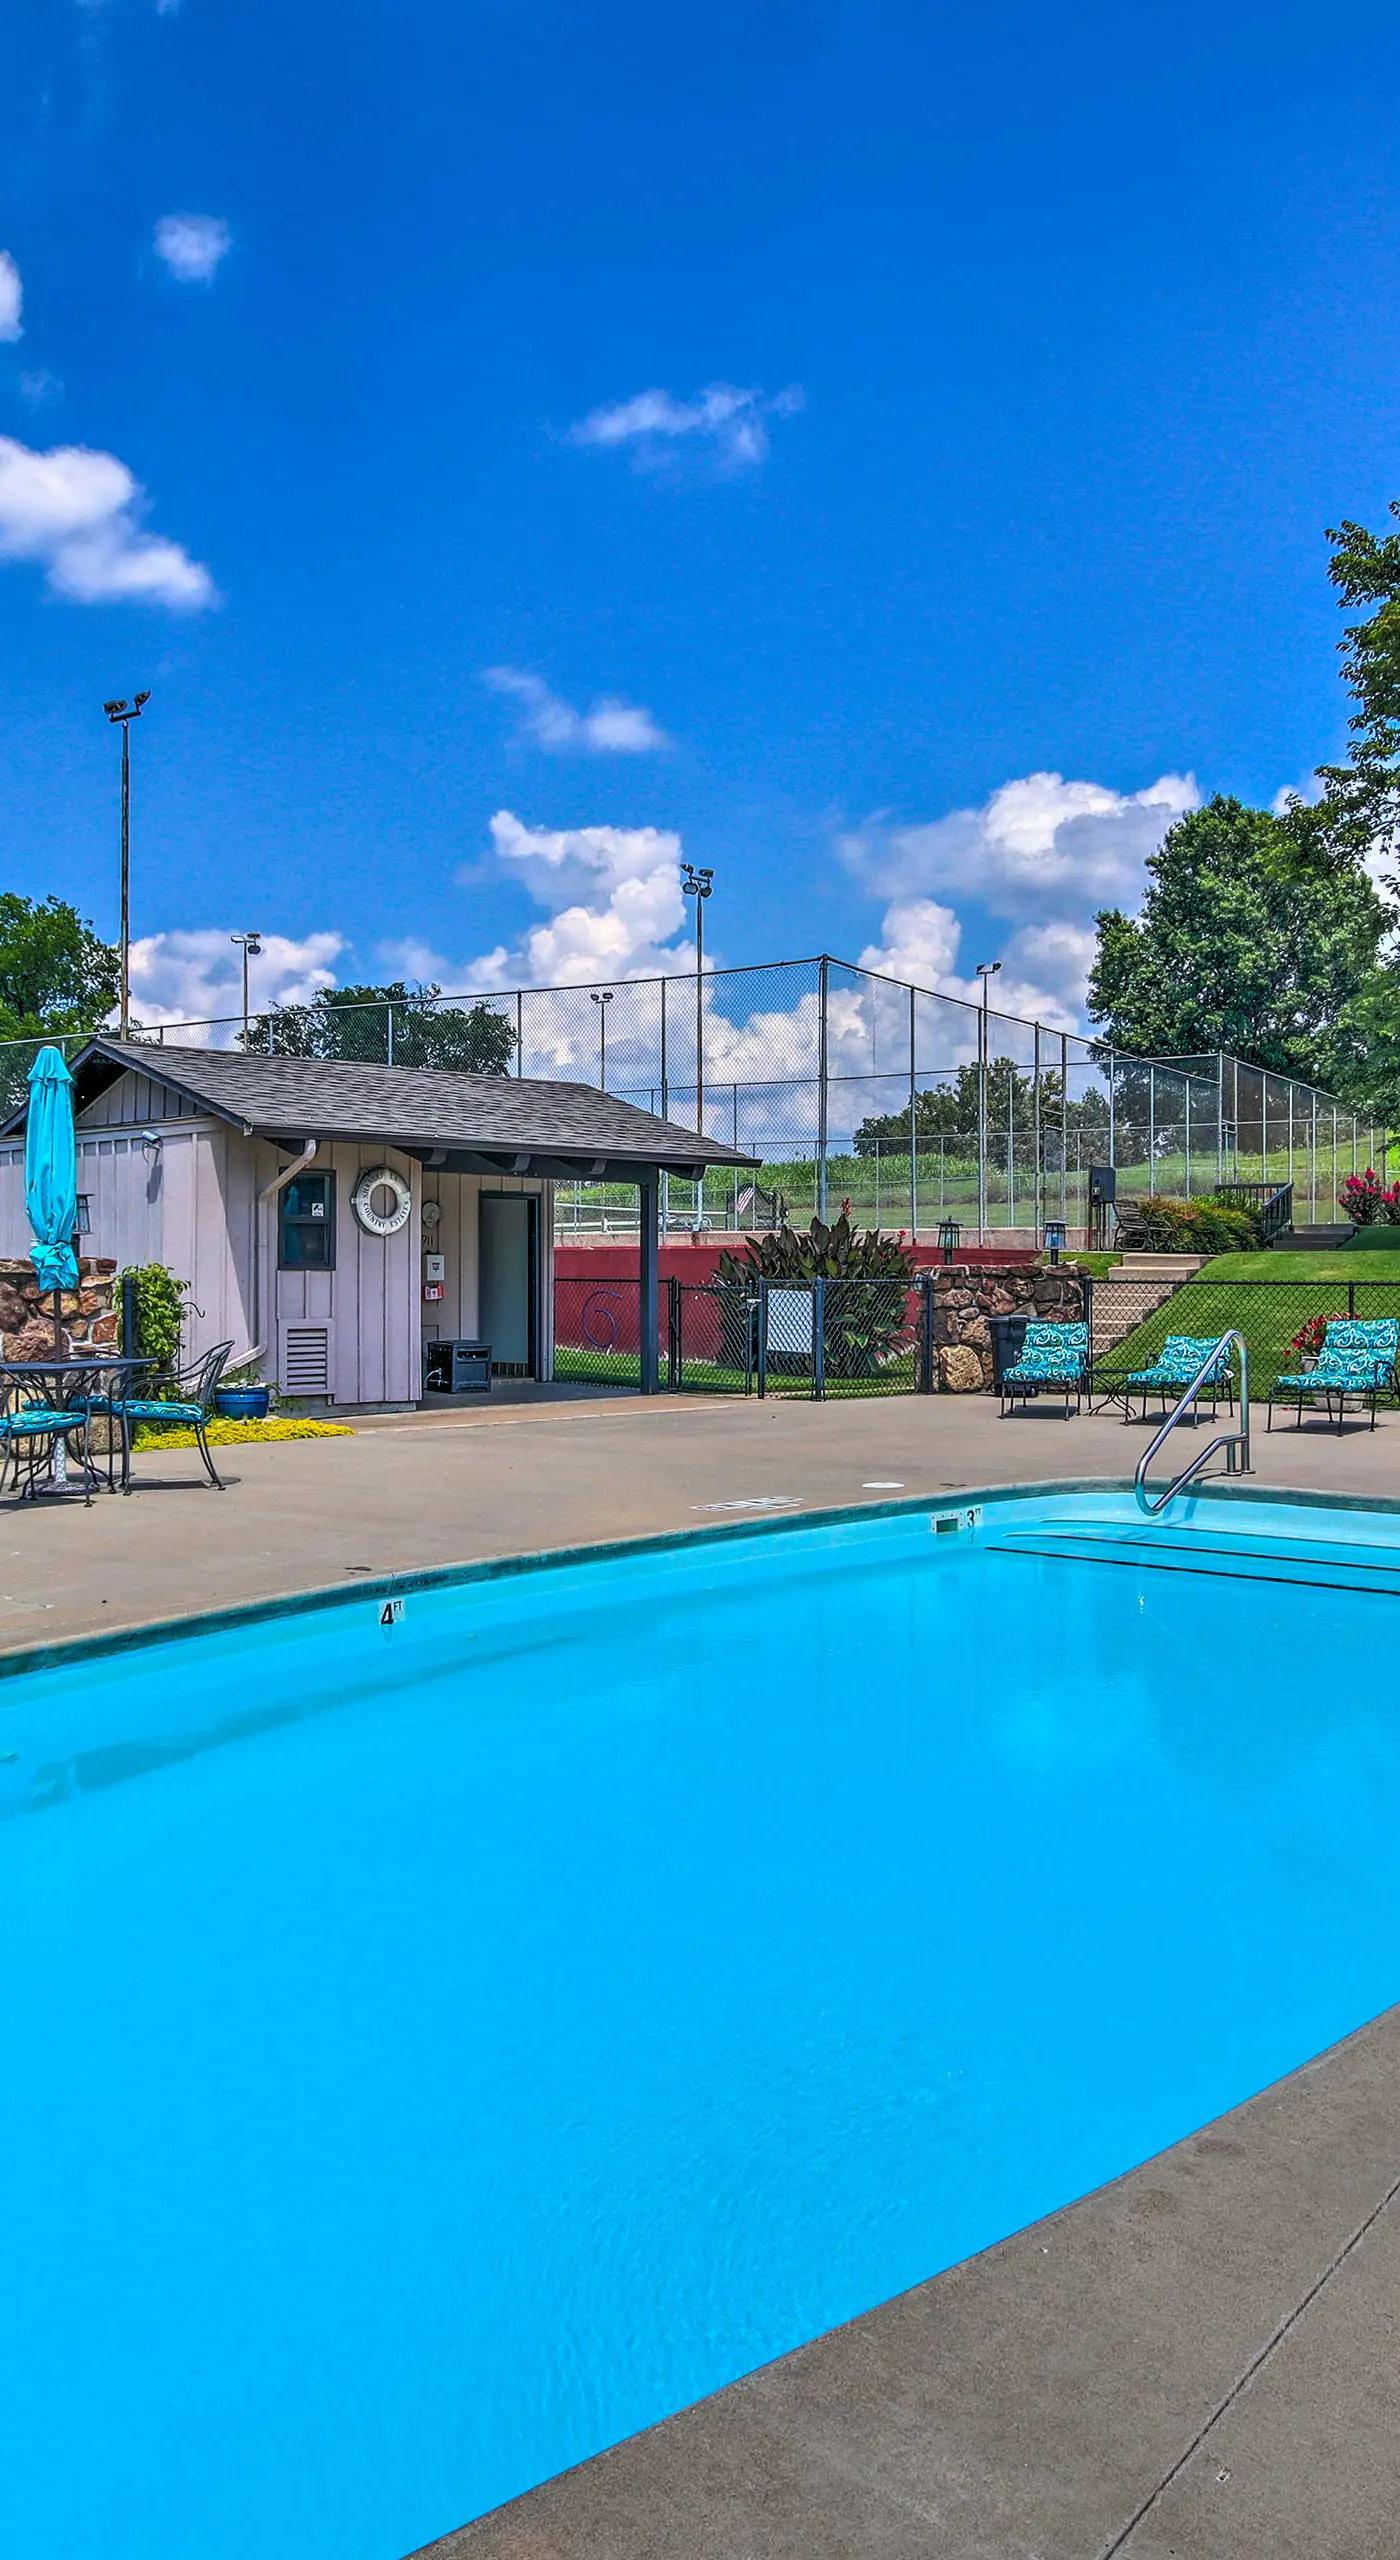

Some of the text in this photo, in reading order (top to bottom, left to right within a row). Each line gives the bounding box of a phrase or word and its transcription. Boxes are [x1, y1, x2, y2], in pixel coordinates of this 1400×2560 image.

[363, 1201, 409, 1228] COUNTRY ESTATES
[421, 1235, 433, 1245] 911
[967, 1509, 974, 1528] 3
[381, 1601, 402, 1625] 4 FT
